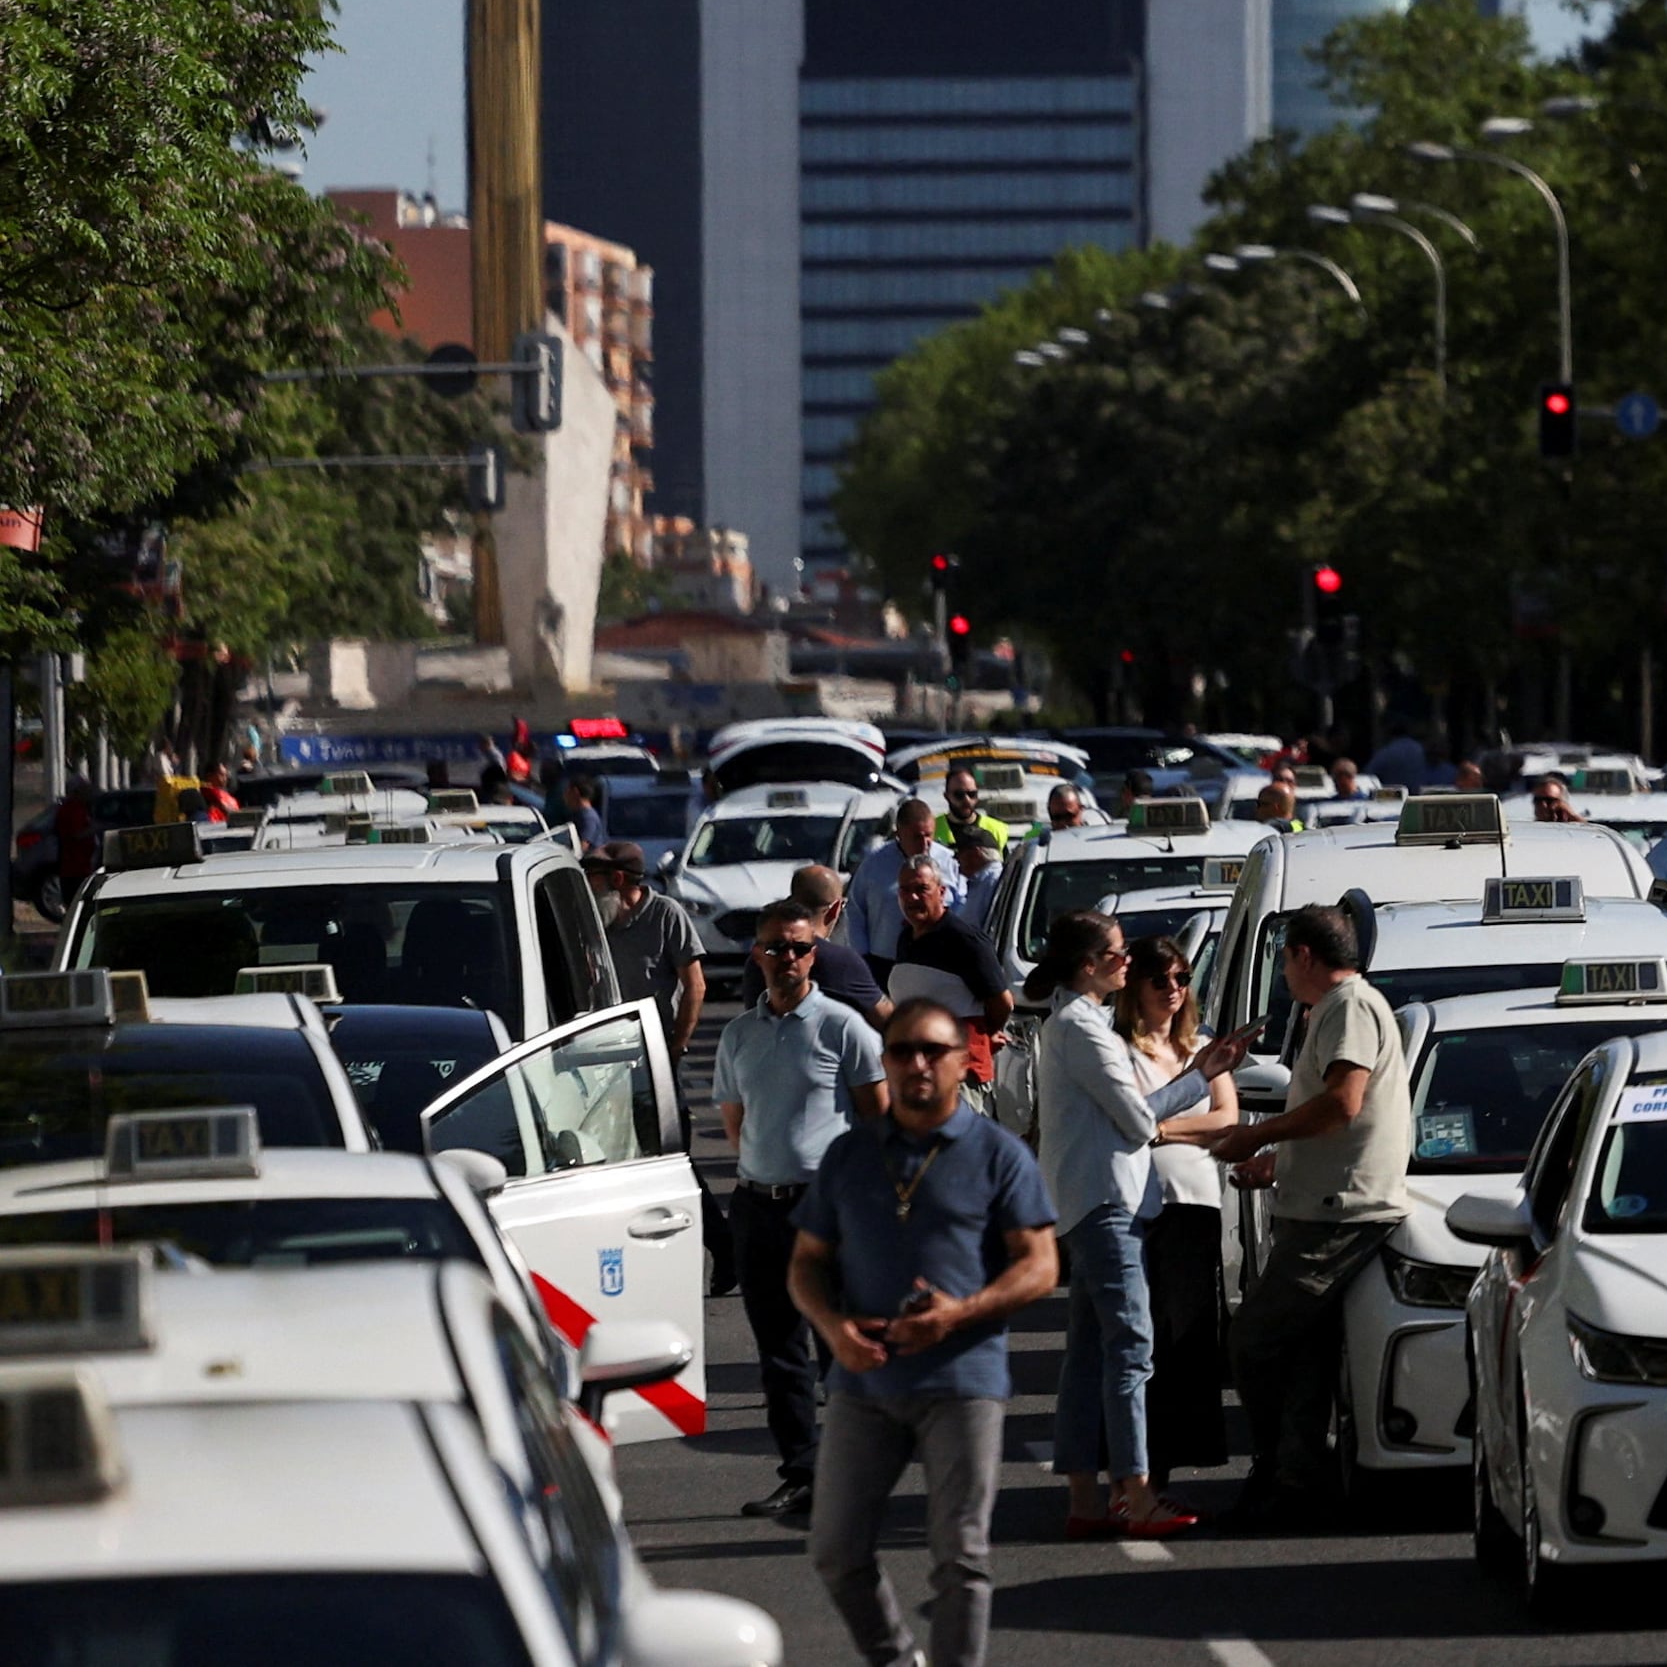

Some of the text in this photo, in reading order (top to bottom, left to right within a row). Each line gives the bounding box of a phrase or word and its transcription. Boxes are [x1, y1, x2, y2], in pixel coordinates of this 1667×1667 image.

[1222, 864, 1241, 881] TA
[1505, 885, 1549, 906] TAXI
[1588, 965, 1635, 990] TAXI
